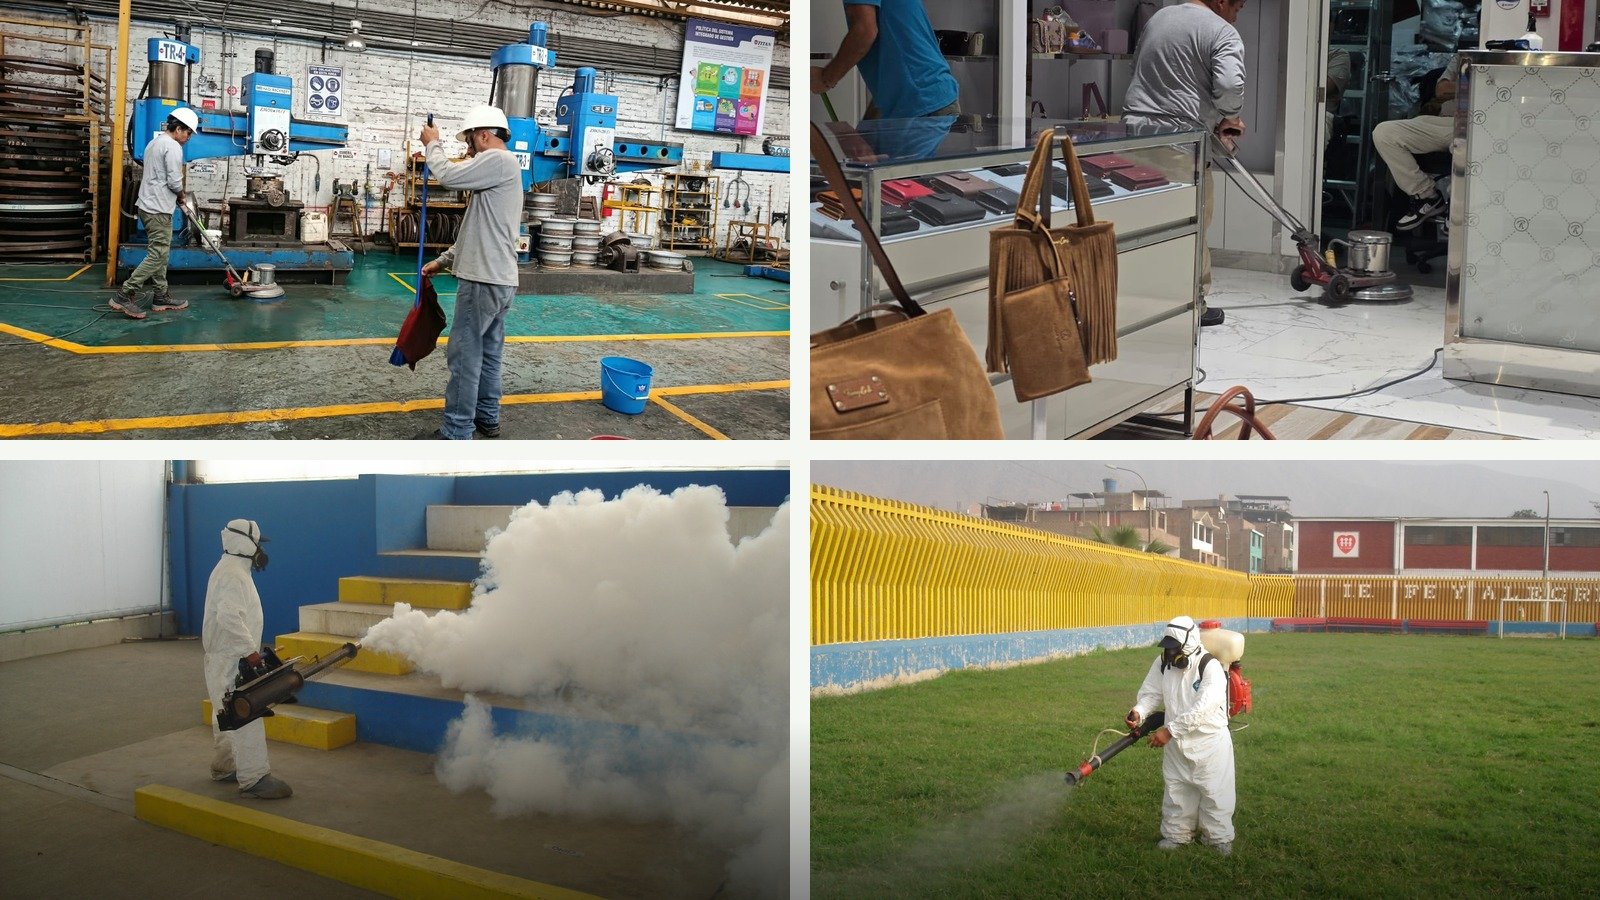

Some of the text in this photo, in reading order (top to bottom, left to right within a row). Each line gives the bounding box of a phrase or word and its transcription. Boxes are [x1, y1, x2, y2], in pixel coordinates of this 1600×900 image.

[163, 43, 183, 61] TR-4
[1404, 584, 1437, 600] FE
[1451, 584, 1467, 600] Y
